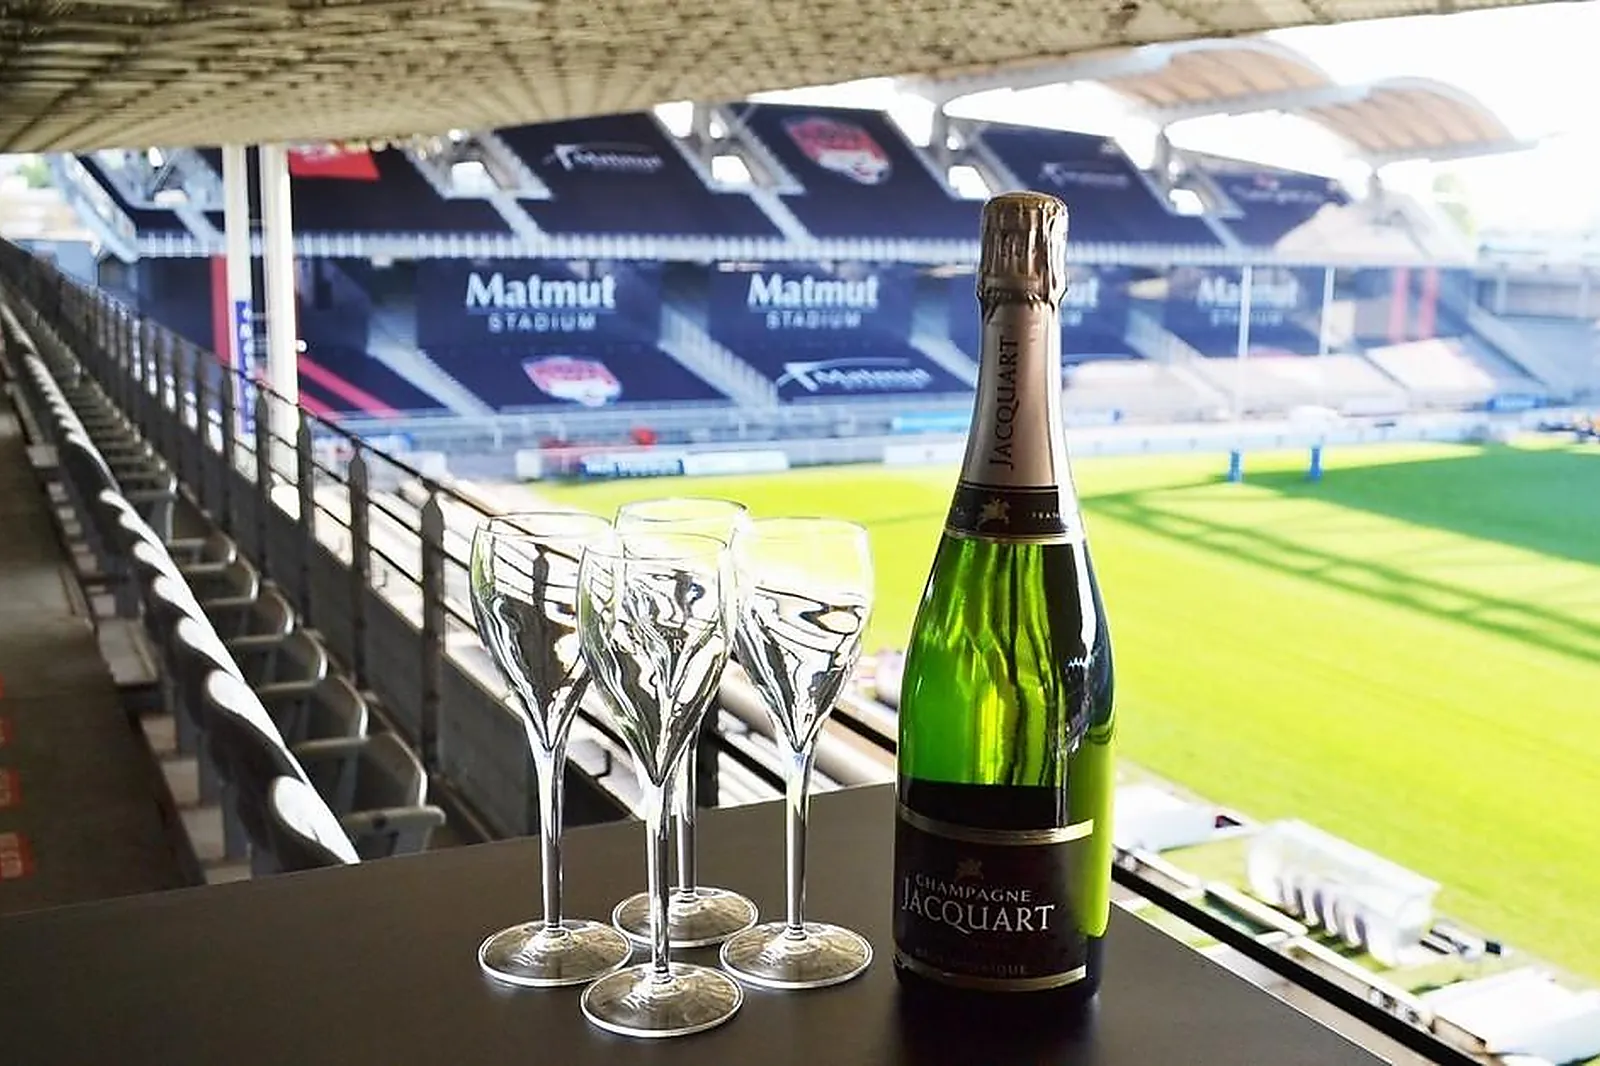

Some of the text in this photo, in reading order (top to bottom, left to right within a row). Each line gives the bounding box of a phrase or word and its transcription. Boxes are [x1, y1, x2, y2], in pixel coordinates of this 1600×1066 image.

[466, 272, 617, 309] Matmut
[748, 273, 878, 309] Matmut
[487, 312, 597, 333] STADIUM
[765, 310, 863, 330] STADIUM
[989, 336, 1020, 471] JACQUART
[902, 876, 1055, 935] JACQUART
[915, 873, 1032, 903] CHAMPAGNE
